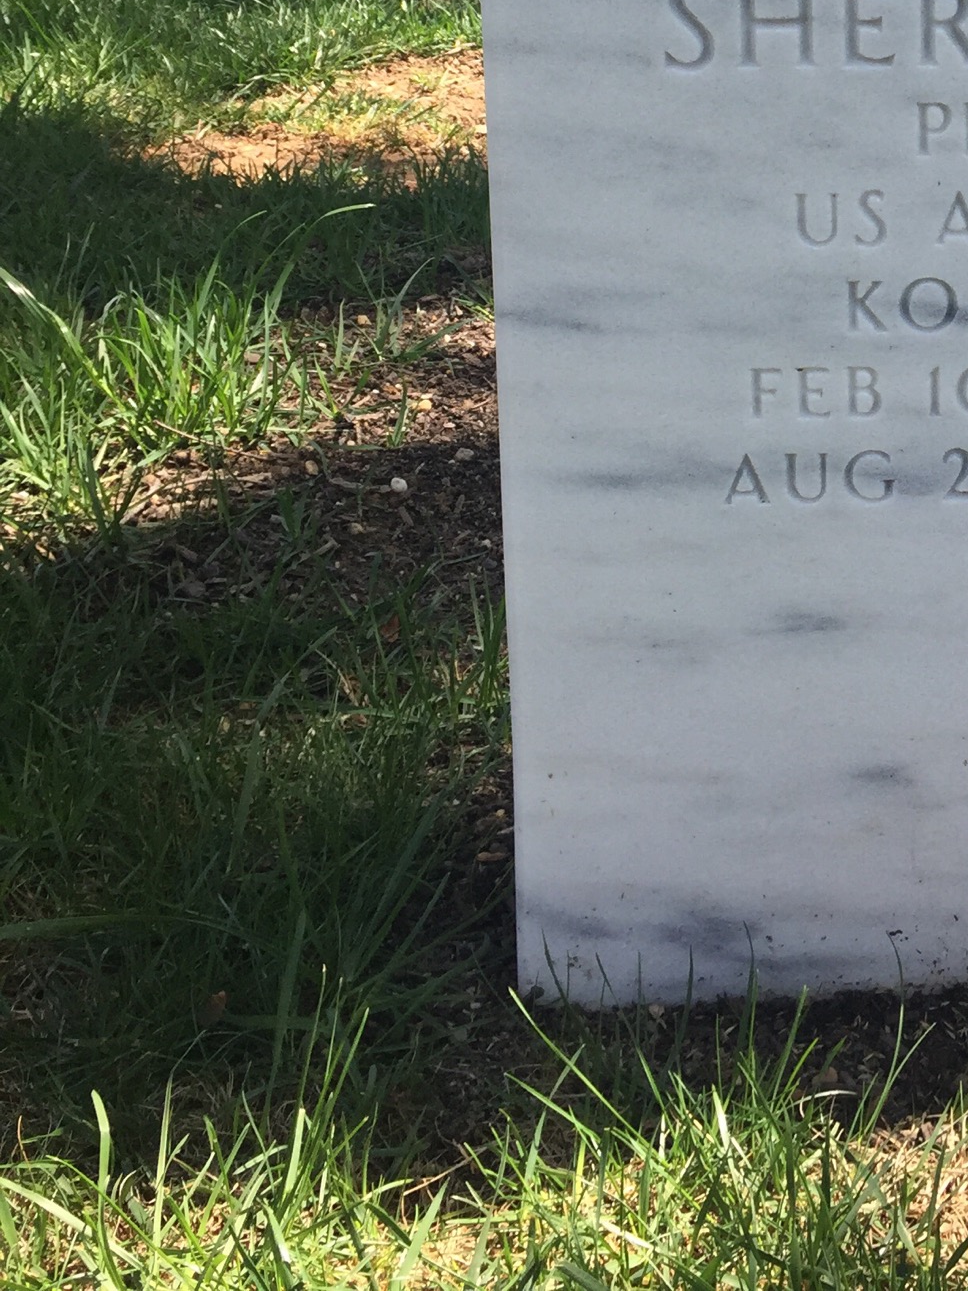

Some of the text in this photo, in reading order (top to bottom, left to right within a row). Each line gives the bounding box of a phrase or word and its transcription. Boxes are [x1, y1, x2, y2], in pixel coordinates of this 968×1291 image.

[794, 189, 888, 247] US
[750, 366, 882, 418] FEB
[724, 448, 895, 504] AUG
